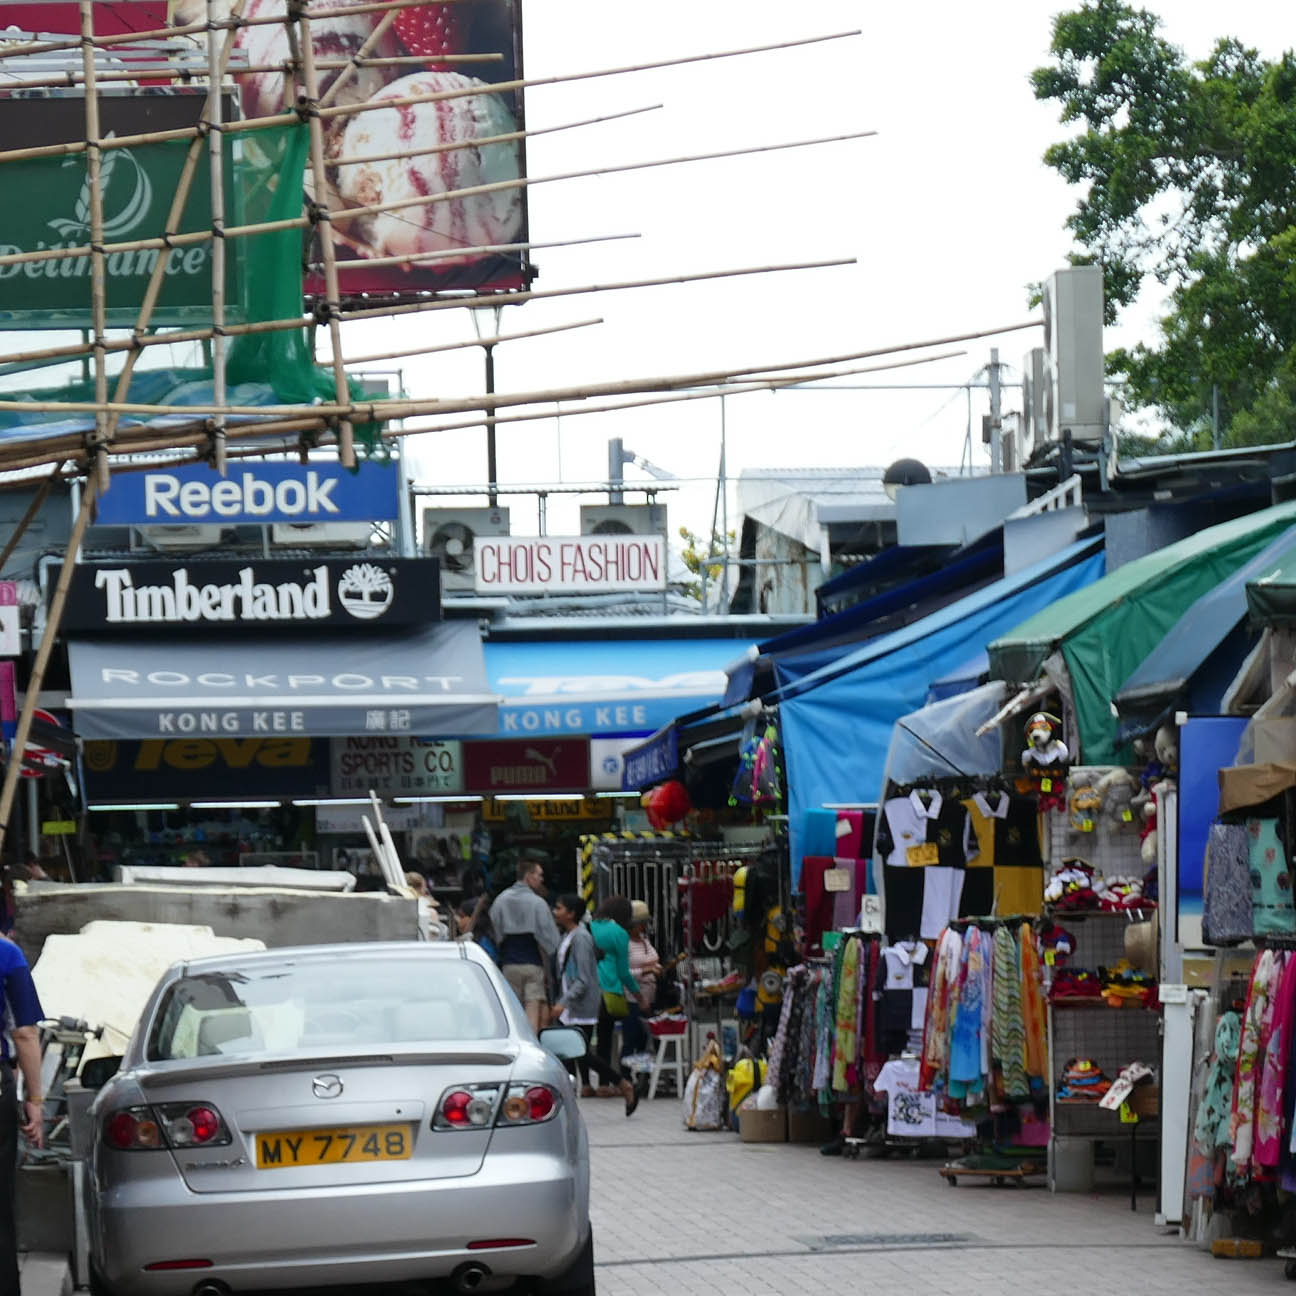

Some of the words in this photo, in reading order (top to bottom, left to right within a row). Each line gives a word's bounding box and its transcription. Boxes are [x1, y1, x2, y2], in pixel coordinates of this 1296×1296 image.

[144, 471, 340, 517] Reebok
[560, 542, 659, 583] FASHION
[94, 565, 332, 623] Timberland
[102, 668, 464, 691] ROCKPORT
[158, 711, 241, 733] KONG
[253, 711, 305, 731] KEE
[503, 709, 583, 731] KONG
[595, 706, 647, 726] KEE
[341, 750, 415, 775] SPORTS
[261, 1137, 303, 1165] MY
[313, 1131, 406, 1161] 7748
